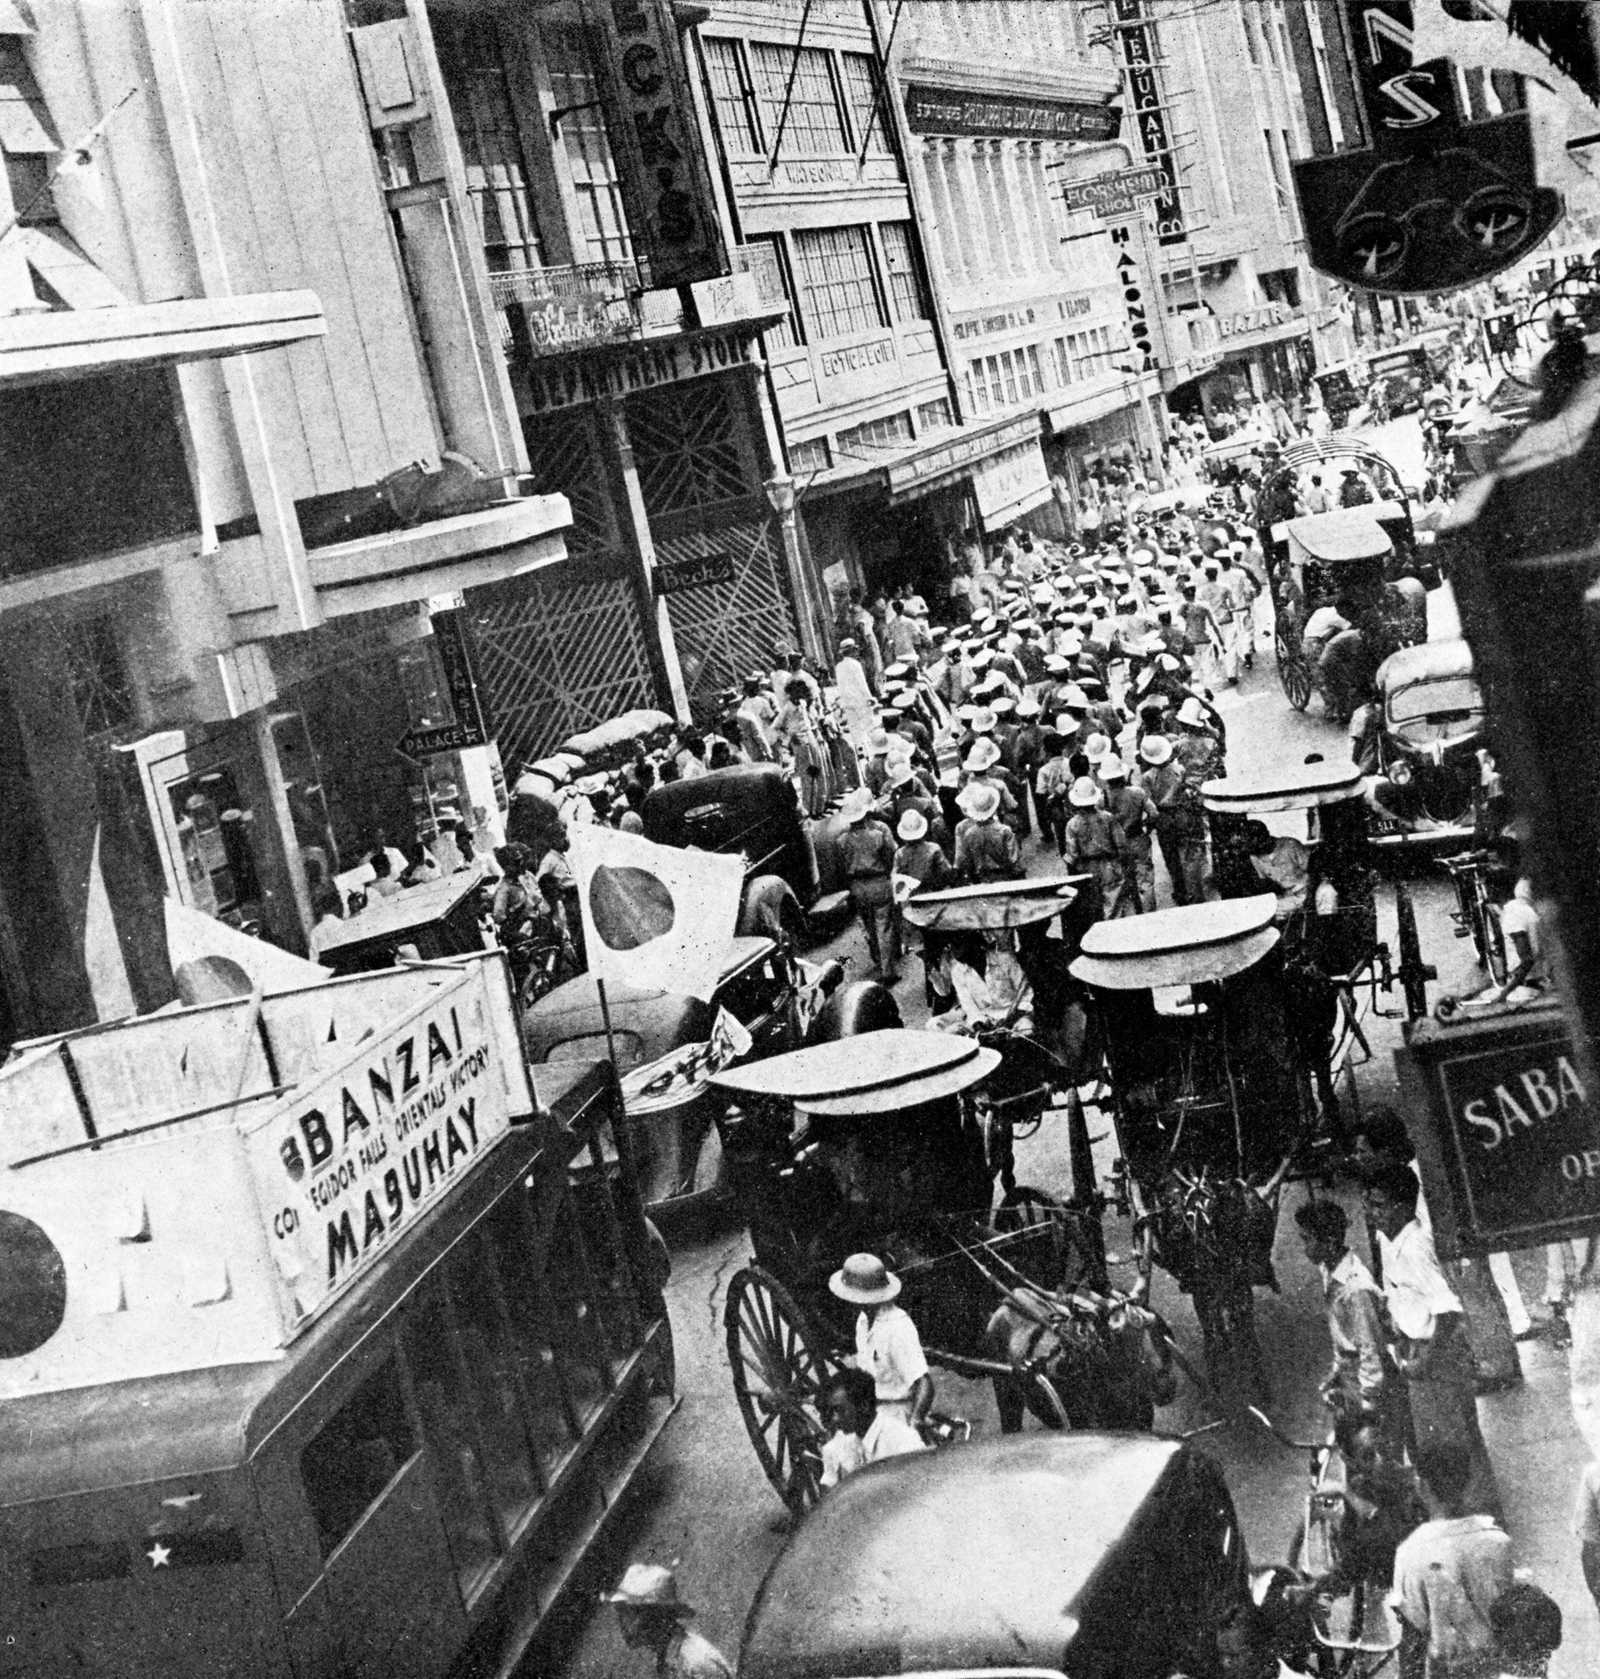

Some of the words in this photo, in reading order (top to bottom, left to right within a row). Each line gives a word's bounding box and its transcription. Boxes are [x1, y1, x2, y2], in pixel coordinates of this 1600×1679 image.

[1067, 173, 1157, 204] FLORSHEIM
[1097, 197, 1132, 215] SHOE
[1217, 303, 1284, 339] BAZAR
[406, 730, 462, 751] PALACE
[359, 1133, 388, 1174] FALLS
[450, 1044, 489, 1094] VICTORY
[327, 1097, 479, 1280] MABUHAY
